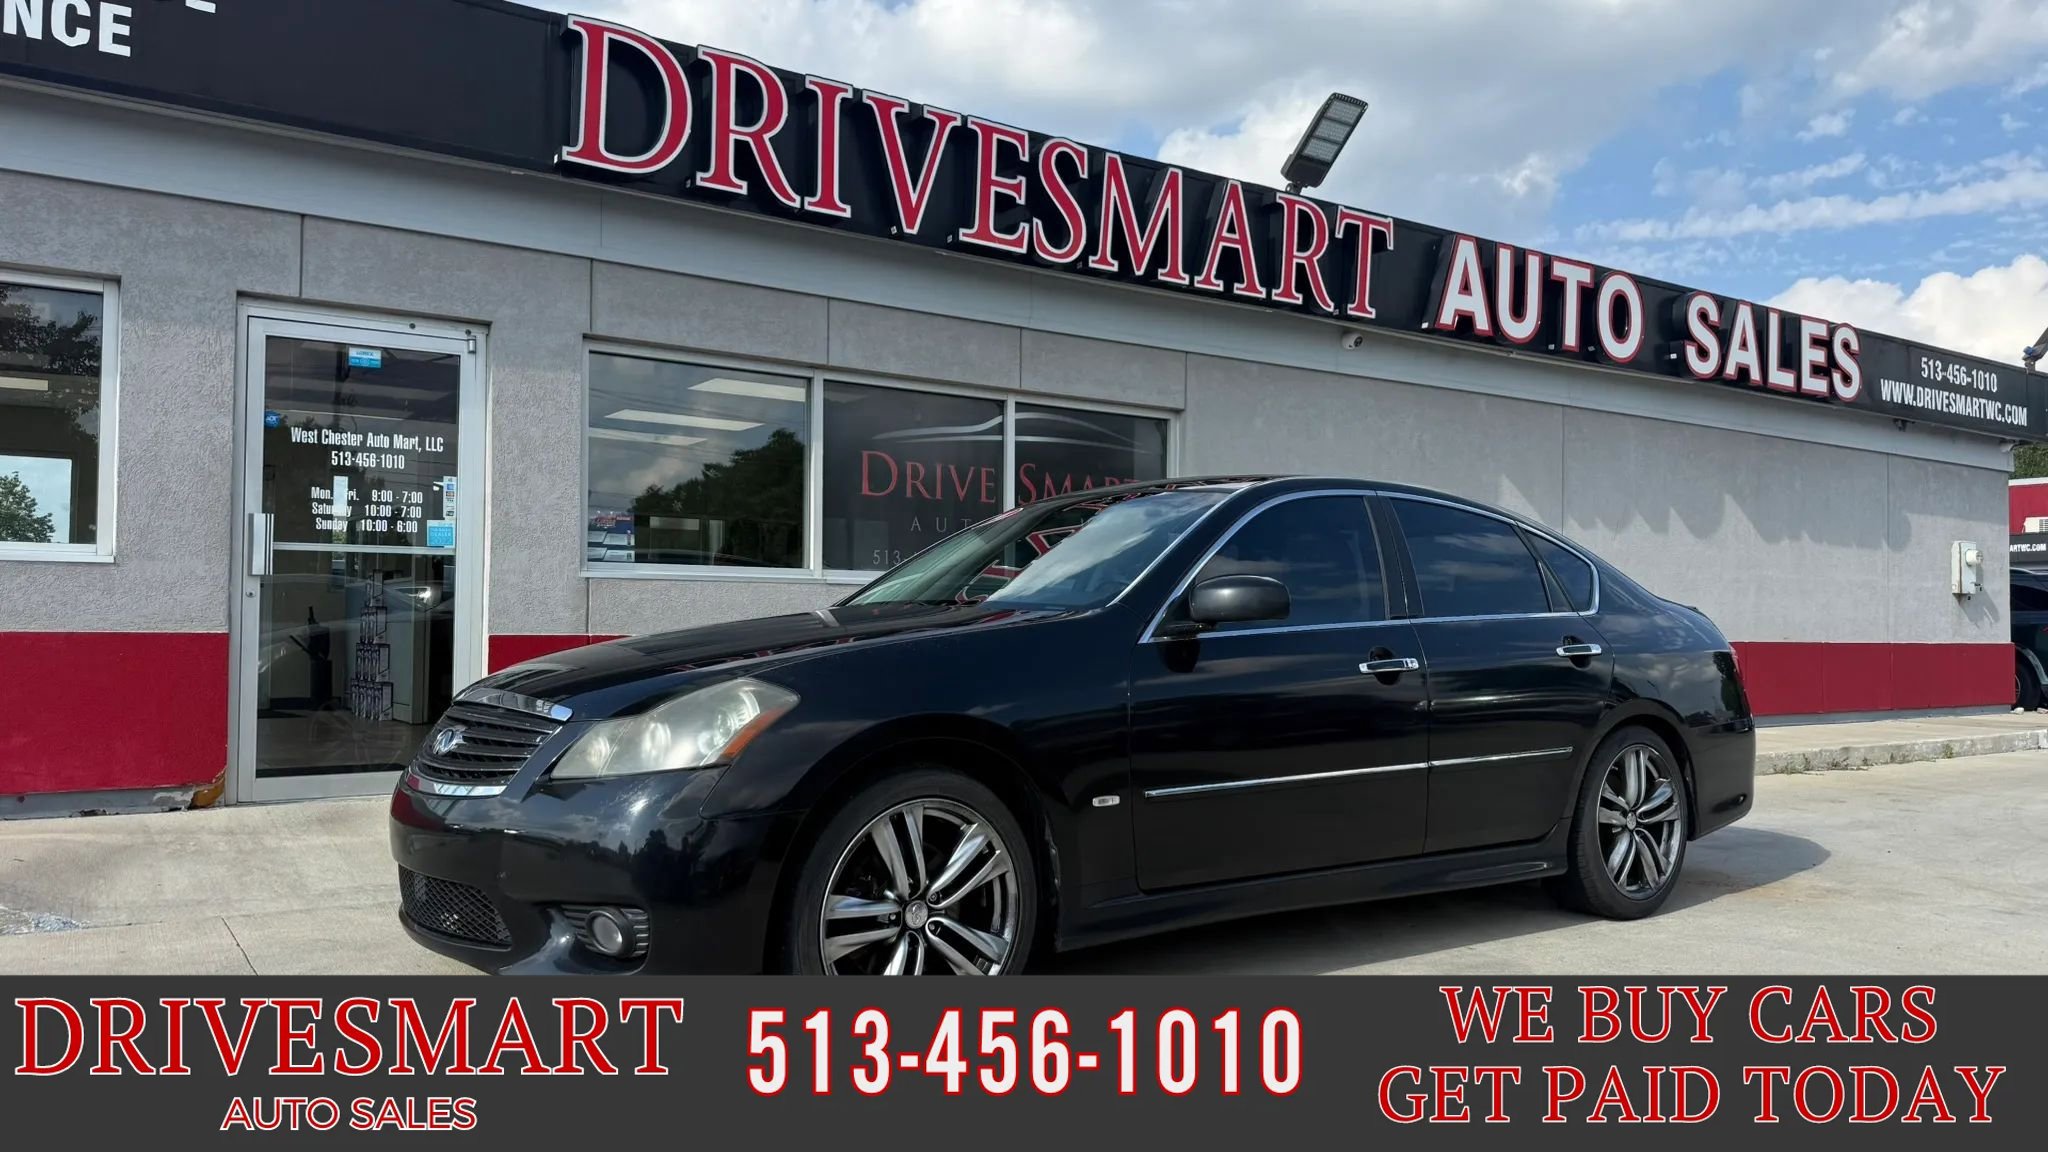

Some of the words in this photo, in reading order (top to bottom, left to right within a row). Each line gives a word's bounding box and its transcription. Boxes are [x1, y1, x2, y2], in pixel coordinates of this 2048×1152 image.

[562, 13, 1394, 319] DRIVESMART
[1435, 234, 1645, 363] AUTO
[1684, 290, 1863, 402] SALES
[1920, 357, 1998, 393] 513-456-1010
[1880, 378, 2028, 427] WWW.DRIVESMARTWC.COM
[291, 427, 318, 444] West
[321, 429, 363, 447] Chester
[367, 432, 390, 448] Auto
[393, 434, 422, 453] Mart,
[425, 436, 444, 452] LLC
[331, 451, 405, 469] 513-456-1010
[311, 487, 333, 500] Mon.
[346, 489, 360, 501] ri.
[371, 489, 393, 502] 9:00
[401, 491, 423, 504] 7:00
[311, 502, 352, 517] Satuy
[364, 504, 392, 517] 10:00
[400, 506, 422, 518] 7:00
[315, 517, 348, 532] Sunday
[361, 519, 388, 532] 10:00
[396, 520, 418, 533] 6:00
[910, 517, 969, 533] AUT
